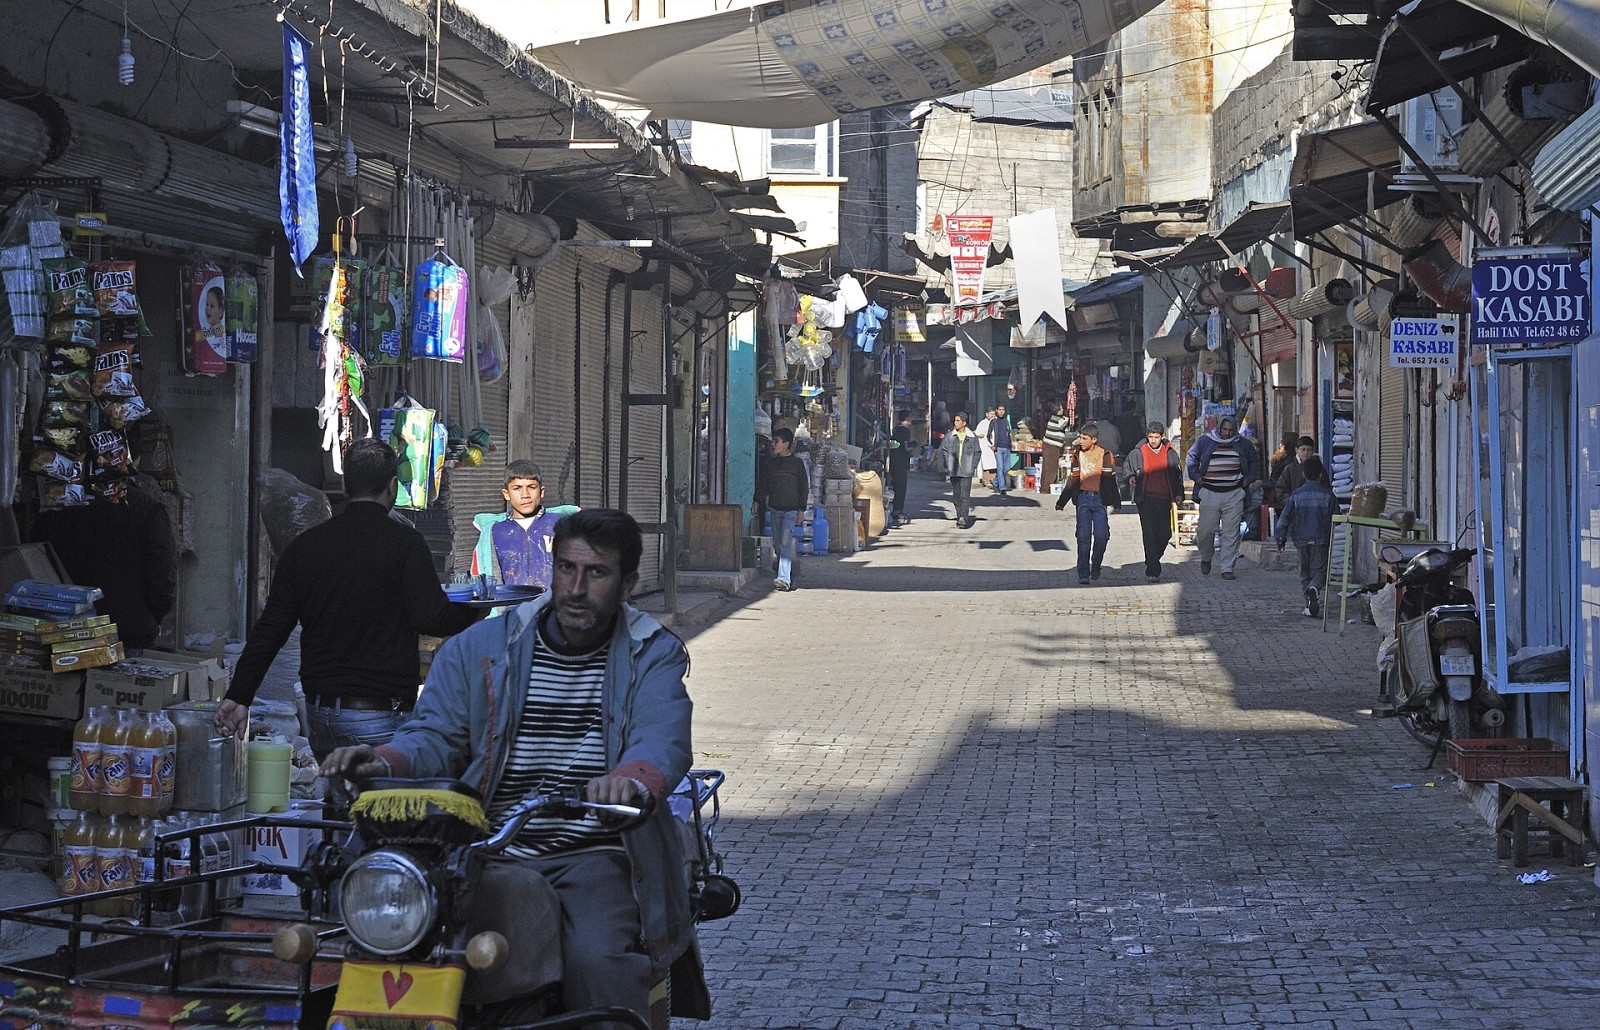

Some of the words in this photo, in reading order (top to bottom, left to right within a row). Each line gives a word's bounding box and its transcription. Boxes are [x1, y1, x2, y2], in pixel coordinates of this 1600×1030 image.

[94, 271, 132, 289] Patos
[1489, 264, 1572, 292] DOST
[1476, 295, 1585, 323] KASABI
[416, 312, 432, 334] Evy
[428, 311, 441, 340] Baby
[1477, 328, 1499, 338] Halil
[1500, 327, 1520, 338] TAN
[1557, 326, 1568, 336] 48
[1570, 326, 1580, 337] 65
[1392, 340, 1454, 354] KASABI
